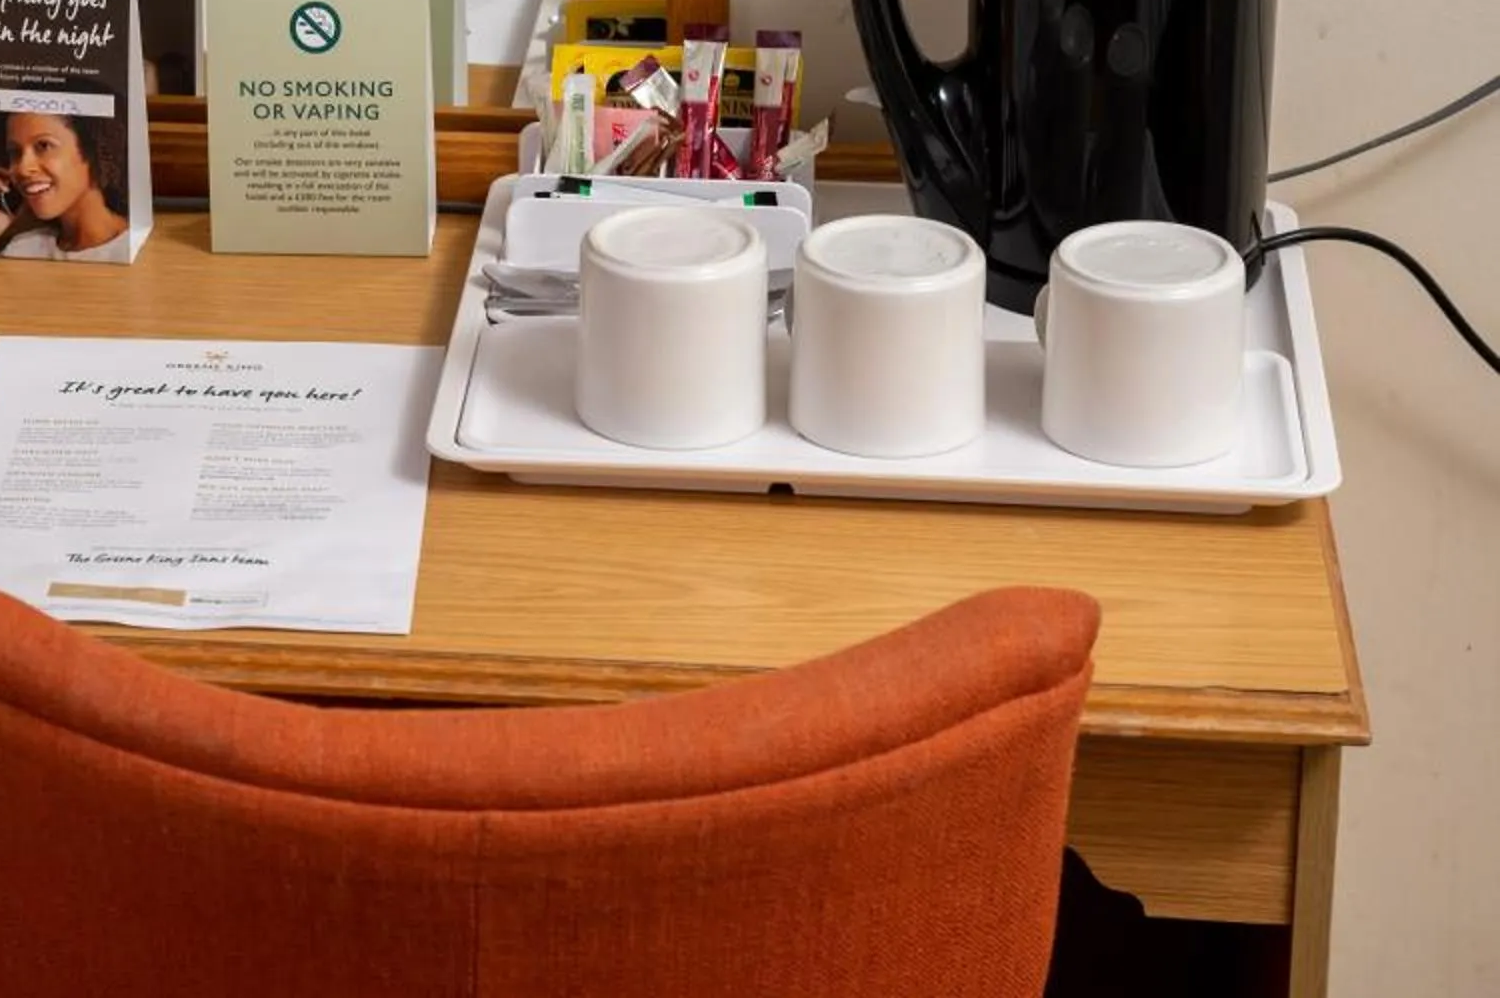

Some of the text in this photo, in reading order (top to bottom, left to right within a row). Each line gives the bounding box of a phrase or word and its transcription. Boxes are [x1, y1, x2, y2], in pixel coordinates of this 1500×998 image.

[19, 17, 52, 44] the
[57, 21, 115, 60] night
[239, 80, 393, 98] NO SMOKING
[253, 103, 380, 121] OR VAPING
[59, 380, 363, 403] It's great to have you here!
[67, 553, 270, 567] The Greene King Inns team
